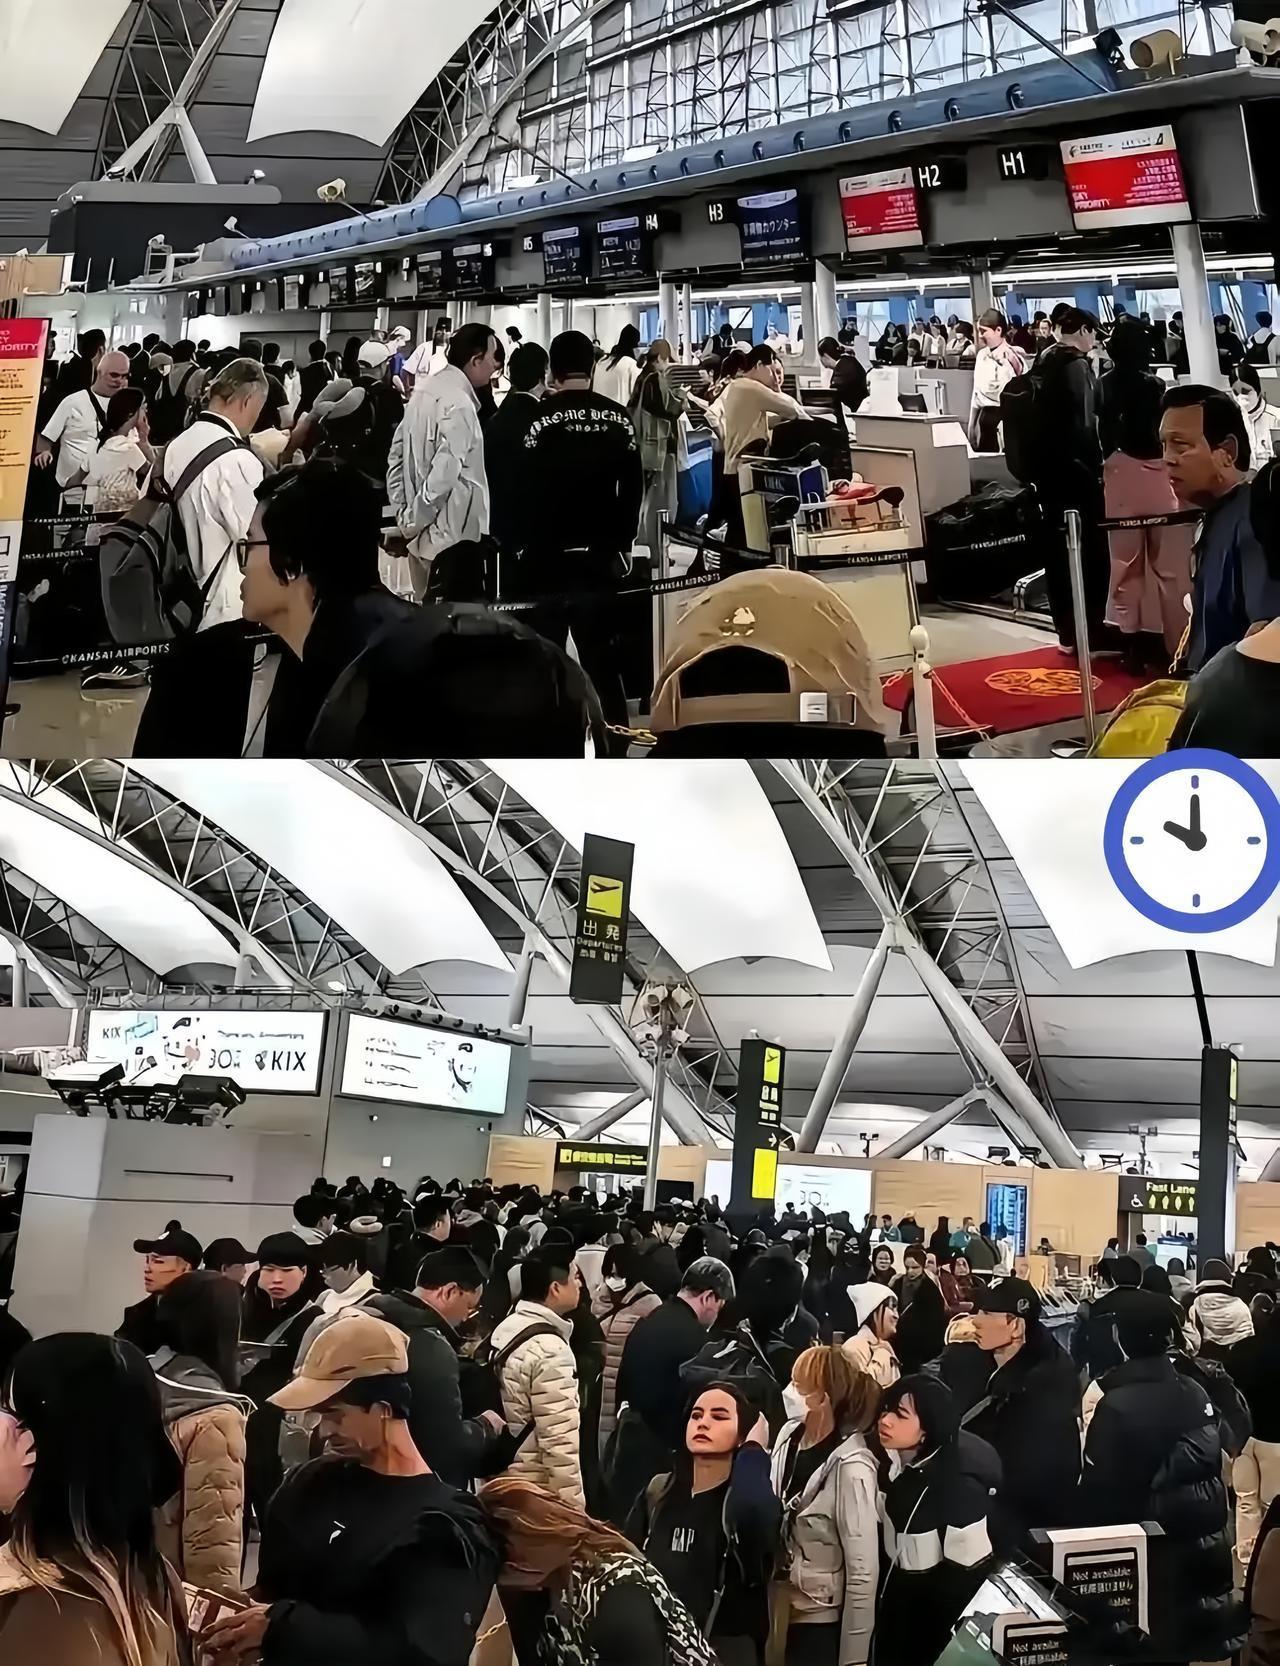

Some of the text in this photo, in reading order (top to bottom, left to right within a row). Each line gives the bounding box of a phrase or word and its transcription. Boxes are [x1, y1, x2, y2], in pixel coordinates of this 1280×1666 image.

[1002, 151, 1026, 176] H1
[918, 164, 942, 188] H2
[708, 203, 724, 222] H3
[645, 213, 659, 231] H4
[115, 643, 170, 659] AIRPORTS
[102, 1026, 121, 1039] KIX
[271, 1050, 307, 1072] KIX
[1146, 1181, 1196, 1195] Fast Lane
[671, 1527, 696, 1553] GAP
[1072, 1571, 1089, 1581] Not
[1012, 1643, 1029, 1653] Not
